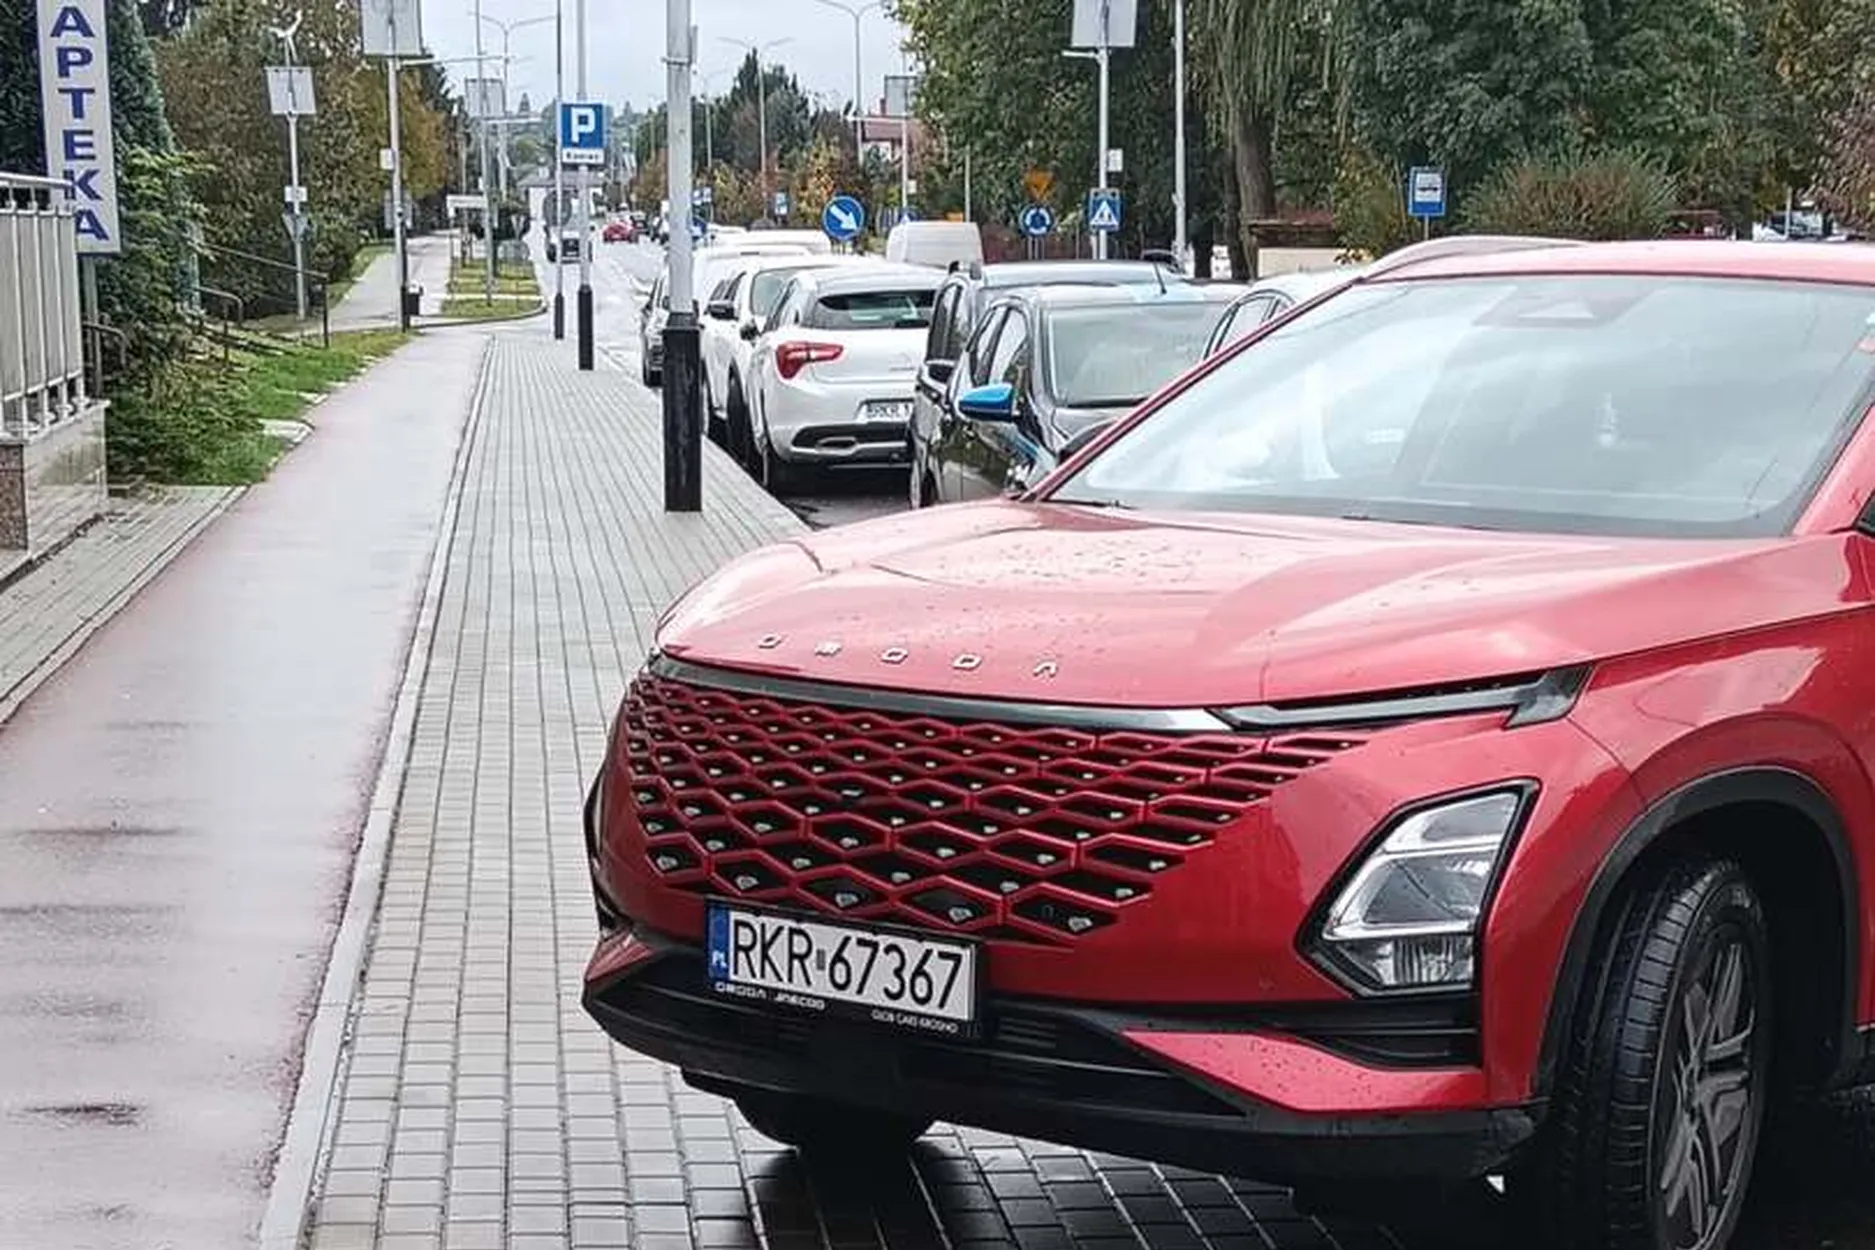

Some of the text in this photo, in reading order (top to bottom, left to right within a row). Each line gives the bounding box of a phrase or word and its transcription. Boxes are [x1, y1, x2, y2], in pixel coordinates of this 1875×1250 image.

[50, 6, 110, 241] APTEKA
[571, 107, 596, 143] P
[758, 632, 1058, 679] OMODA
[732, 919, 963, 1010] RKR 67367
